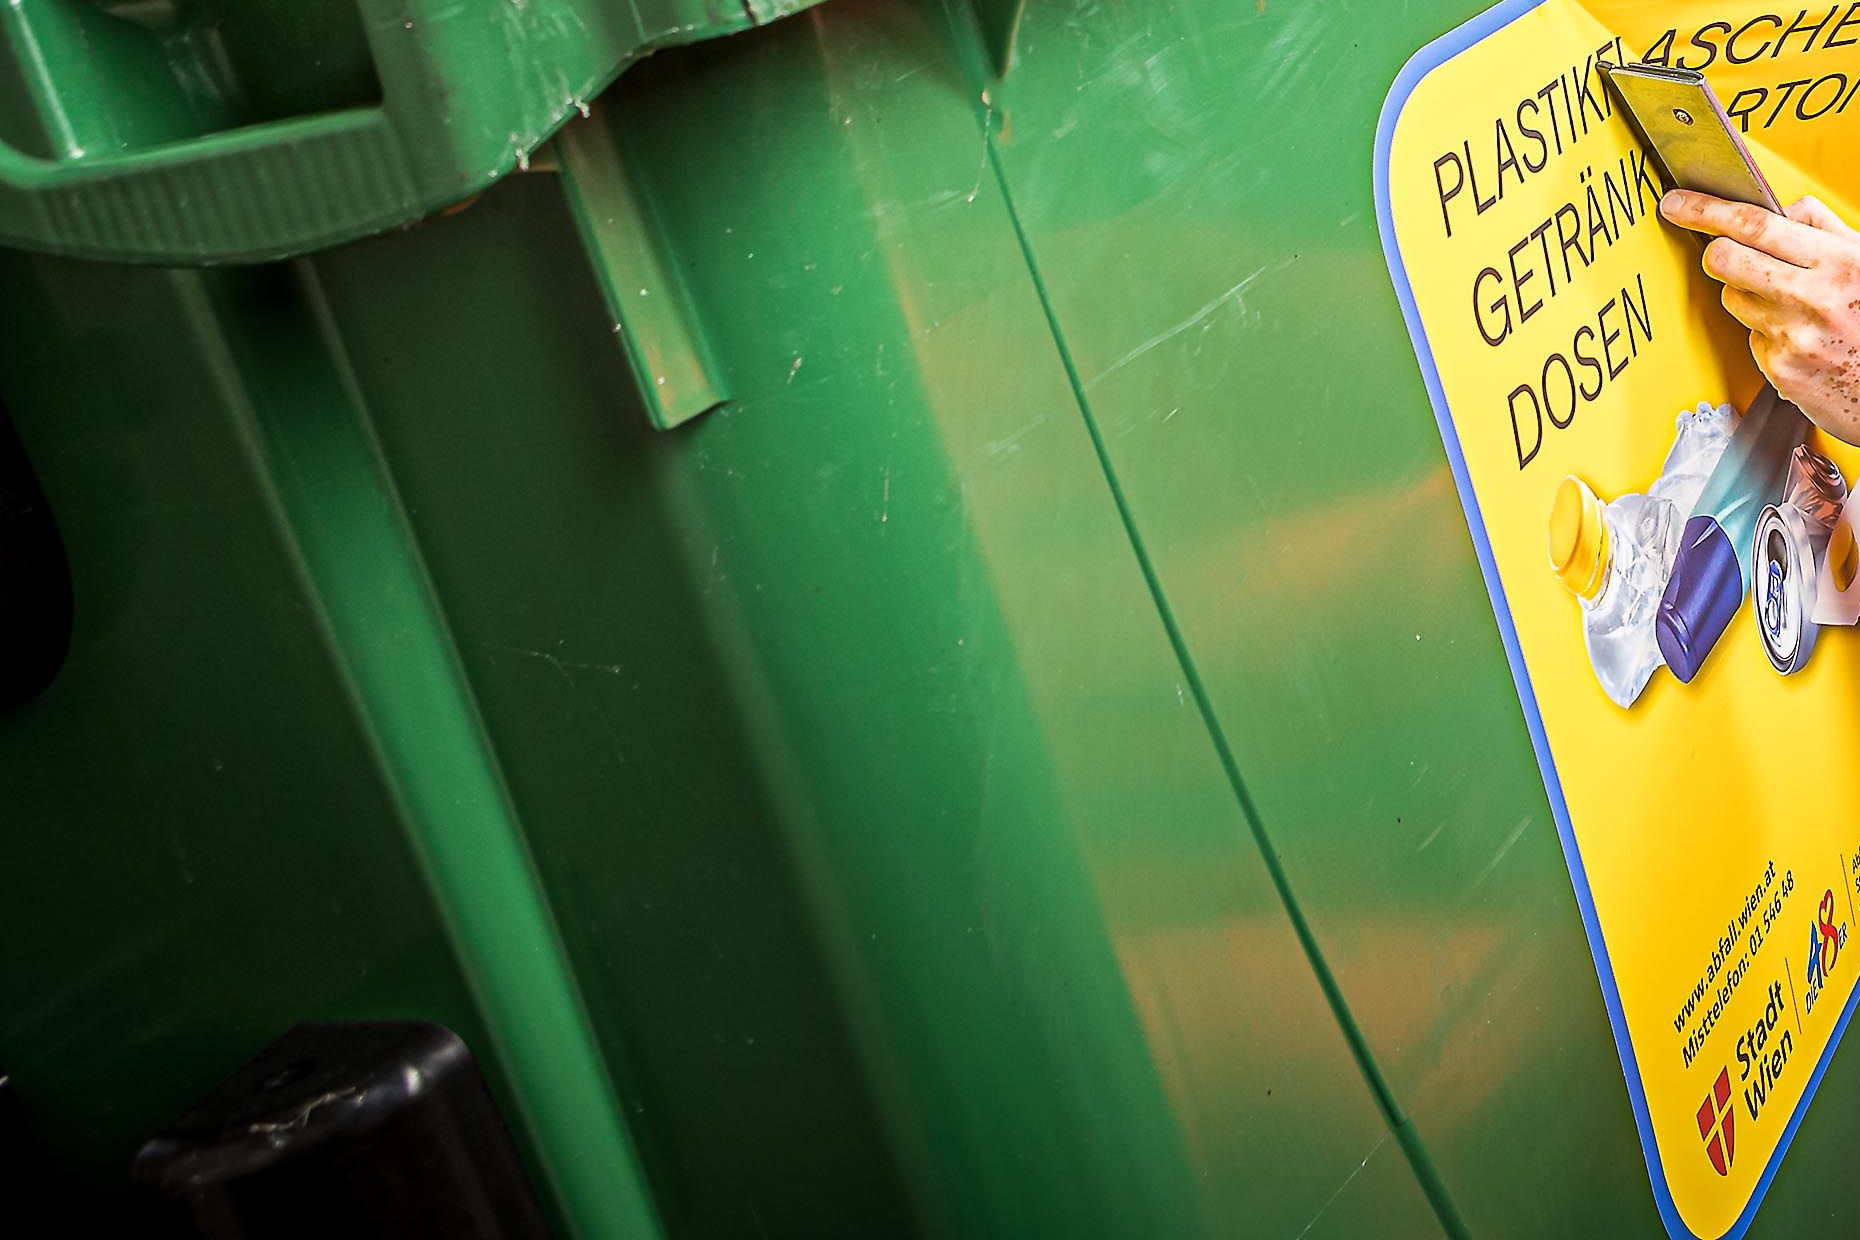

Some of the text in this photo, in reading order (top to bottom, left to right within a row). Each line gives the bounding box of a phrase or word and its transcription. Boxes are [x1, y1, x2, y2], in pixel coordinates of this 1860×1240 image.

[1507, 273, 1653, 471] DOSEN
[1674, 860, 1776, 1033] www.abfall.wien.at
[1682, 869, 1794, 1069] Misttelefon: 01 546 48
[1805, 979, 1818, 1015] DIE
[1736, 980, 1785, 1082] Stadt
[1744, 1030, 1793, 1121] Wien
